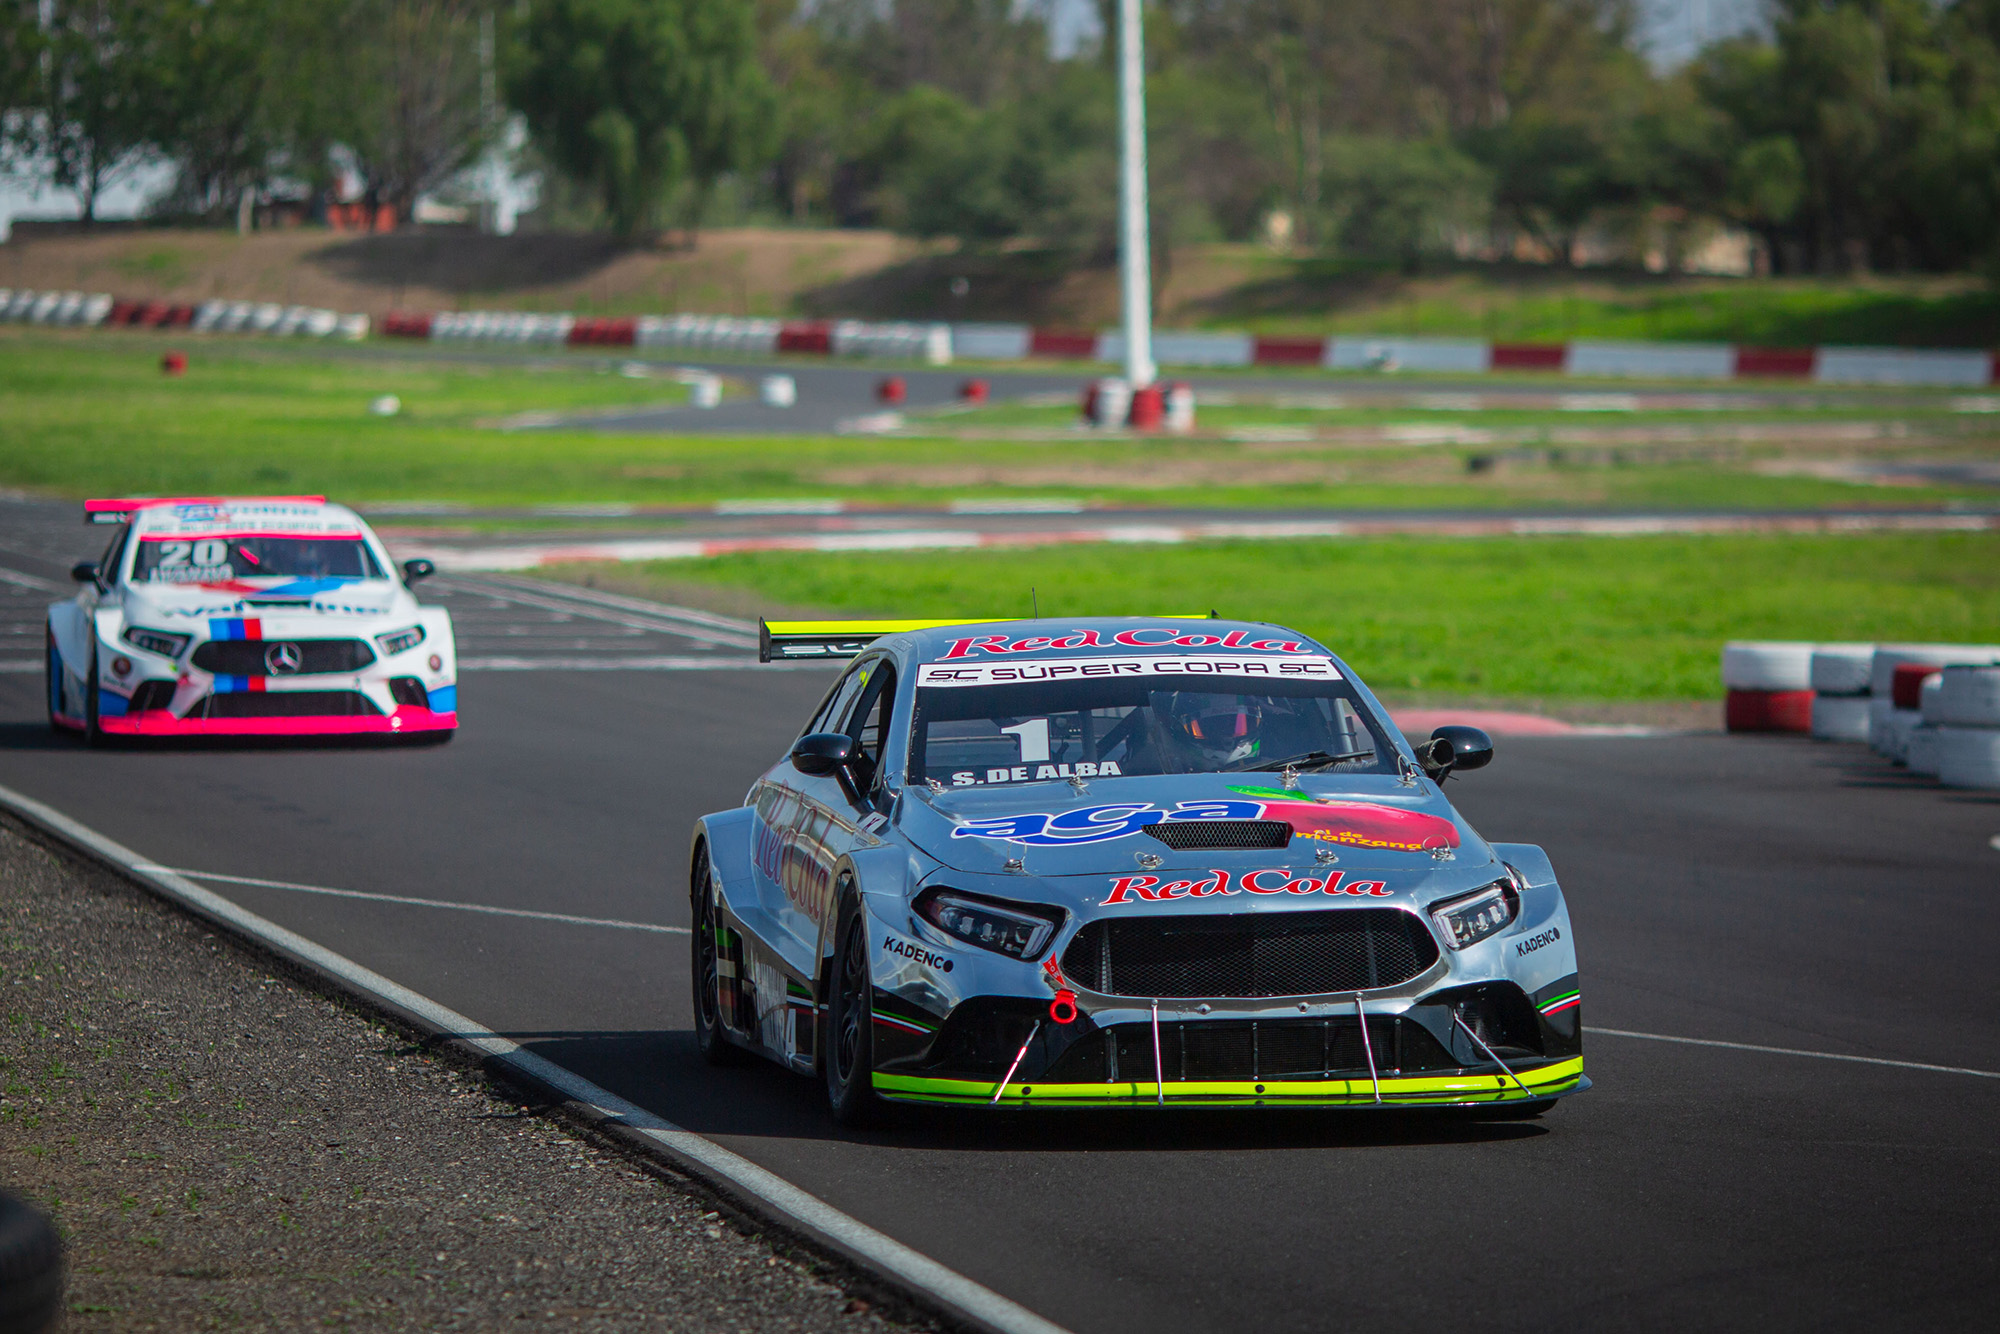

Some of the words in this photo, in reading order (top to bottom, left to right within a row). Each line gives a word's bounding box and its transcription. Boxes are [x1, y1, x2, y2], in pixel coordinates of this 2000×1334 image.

[159, 539, 228, 568] 20
[934, 628, 1116, 661] Red
[1114, 628, 1312, 655] Cola
[926, 668, 983, 680] SC
[991, 662, 1143, 681] SÚPER
[1153, 662, 1269, 674] COPA
[1279, 663, 1328, 673] SC
[1001, 718, 1050, 763] 1
[1035, 760, 1122, 780] ALBA
[950, 800, 1266, 847] aga
[1339, 831, 1363, 839] de
[1295, 831, 1422, 850] manzana
[1098, 869, 1242, 907] Red
[1240, 869, 1394, 897] Cola
